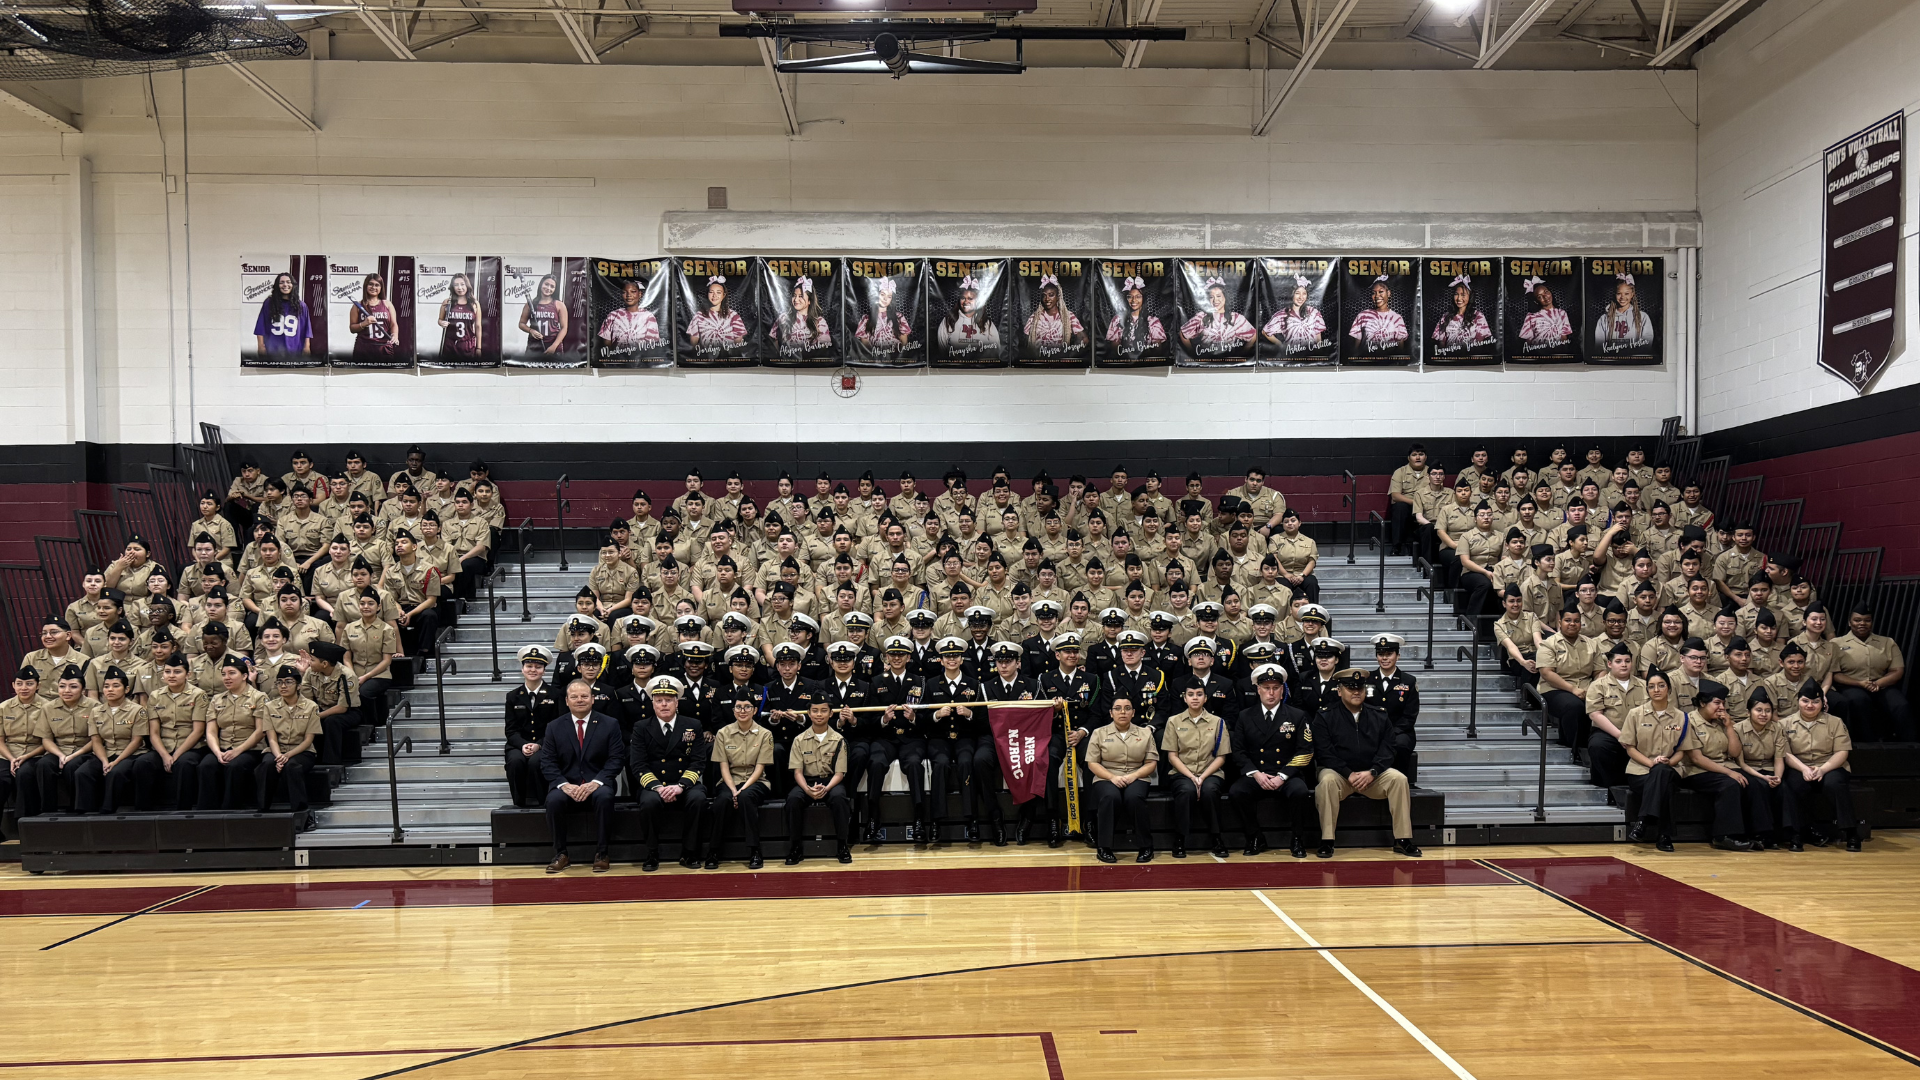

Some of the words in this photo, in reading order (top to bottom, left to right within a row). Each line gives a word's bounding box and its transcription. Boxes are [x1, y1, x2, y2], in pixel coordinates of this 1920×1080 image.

[1827, 145, 1846, 174] BOYS
[1848, 119, 1900, 158] VOLLEYBALL
[1828, 151, 1900, 194] CHAMPIONSHIPS
[271, 314, 298, 337] 99
[456, 322, 465, 338] 3
[1136, 340, 1159, 352] Brown
[1548, 338, 1571, 350] Brown
[1008, 729, 1024, 780] NJROTC
[1067, 777, 1075, 801] AWARD
